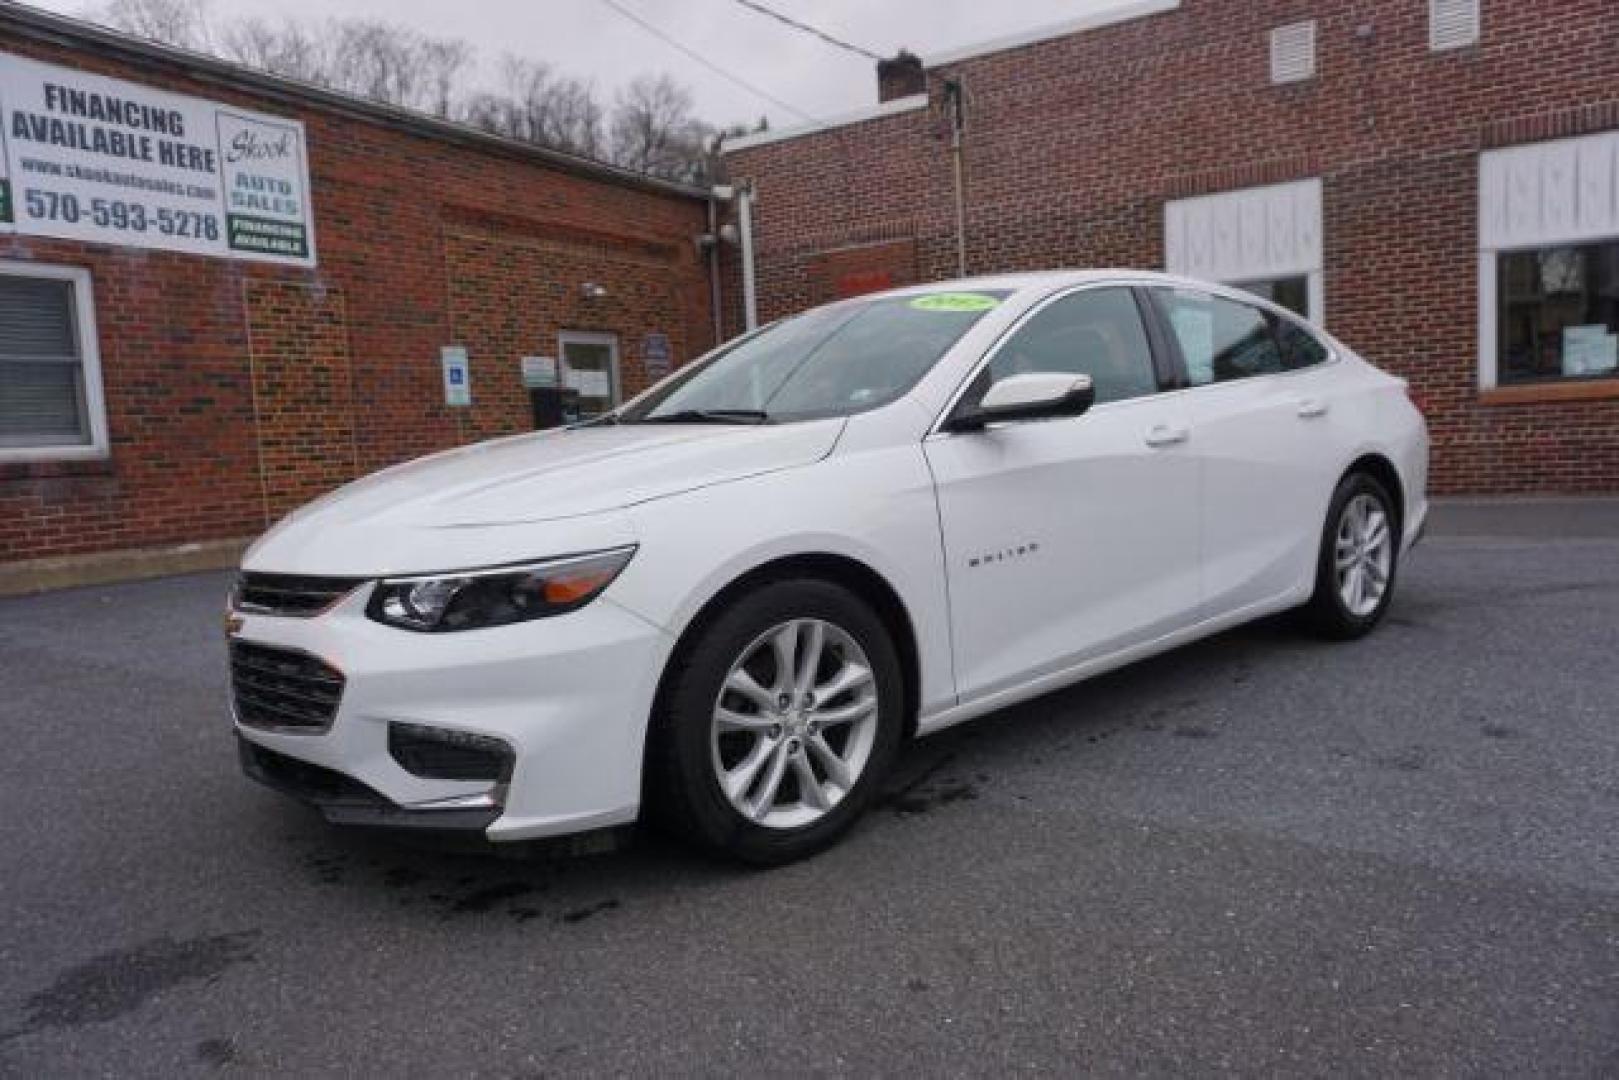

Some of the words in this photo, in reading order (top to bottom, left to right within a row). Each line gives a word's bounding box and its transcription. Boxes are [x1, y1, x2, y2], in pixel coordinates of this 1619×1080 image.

[44, 83, 184, 136] FINANCING
[12, 110, 153, 162] AVAILABLE
[158, 138, 216, 173] HERE
[231, 191, 297, 215] SALES
[235, 172, 292, 195] AUTO
[24, 187, 219, 240] 570-593-5278
